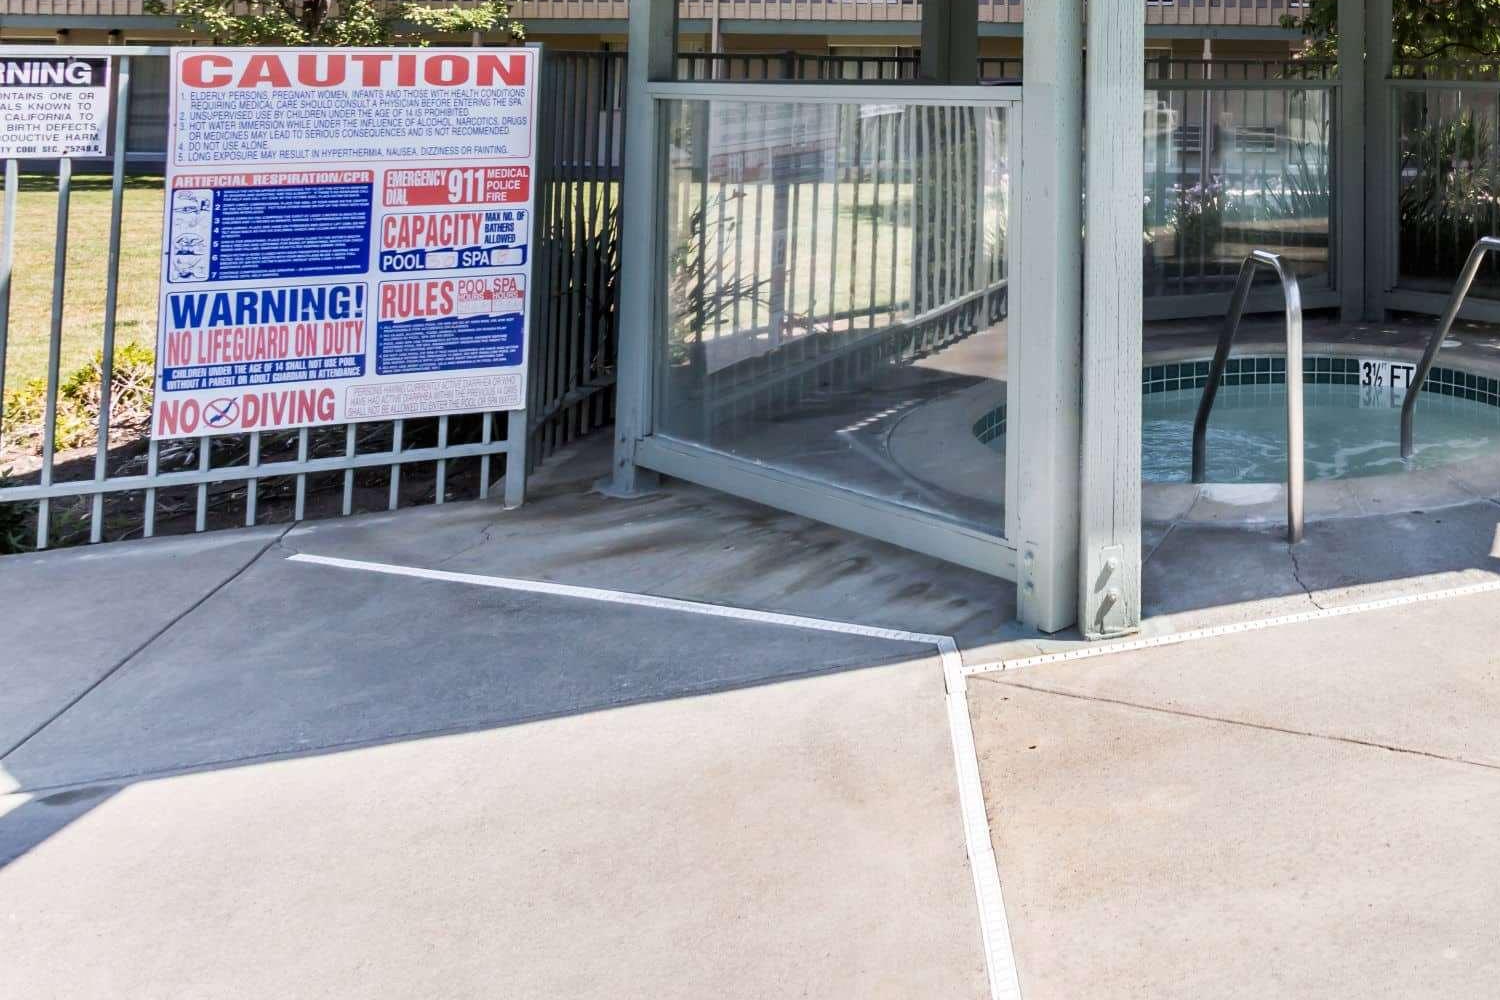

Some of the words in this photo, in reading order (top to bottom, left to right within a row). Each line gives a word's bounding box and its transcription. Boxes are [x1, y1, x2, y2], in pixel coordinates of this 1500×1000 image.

[0, 62, 92, 84] NING
[182, 54, 526, 89] CAUTION
[50, 92, 73, 100] ONE
[79, 92, 94, 100] OR
[190, 91, 225, 99] ELDERLY
[272, 90, 316, 99] PREGNANT
[351, 90, 384, 98] INFANTS
[385, 90, 401, 98] AND
[403, 89, 427, 97] THOSE
[430, 89, 448, 97] WITH
[450, 89, 478, 97] HEALTH
[480, 89, 525, 97] CONDITIONS
[28, 103, 71, 111] KNOWN
[191, 100, 236, 109] REQUIRING
[239, 100, 273, 109] MEDICAL
[276, 100, 298, 109] CARE
[300, 99, 332, 108] SHOULD
[334, 99, 370, 108] CONSULT
[372, 99, 377, 107] A
[379, 99, 419, 107] PHYSICIAN
[421, 98, 450, 107] BEFORE
[453, 98, 490, 107] ENTERING
[492, 98, 507, 106] THE
[5, 113, 72, 121] CALIFORNIA
[190, 110, 252, 120] UNSUPERVISED
[256, 110, 271, 119] USE
[273, 110, 284, 118] BY
[286, 110, 327, 118] CHILDREN
[328, 109, 355, 118] UNDER
[358, 109, 372, 117] THE
[374, 109, 389, 117] AGE
[392, 109, 403, 117] OF
[405, 109, 412, 117] 14
[7, 123, 41, 131] BIRTH
[189, 121, 207, 130] HOT
[209, 121, 235, 130] WATER
[238, 120, 284, 129] IMMERSION
[286, 120, 311, 128] WHILE
[313, 119, 341, 128] UNDER
[343, 119, 357, 128] THE
[360, 118, 403, 127] INFLUENCE
[405, 118, 414, 127] OF
[501, 117, 526, 125] DRUGS
[0, 134, 60, 142] ODUCTIVE
[189, 131, 200, 140] OR
[203, 130, 249, 140] MEDICINES
[251, 130, 267, 139] MAY
[269, 130, 290, 138] LEAD
[291, 130, 303, 138] TO
[304, 129, 340, 138] SERIOUS
[341, 128, 405, 137] CONSEQUENCES
[407, 128, 423, 136] AND
[425, 127, 432, 136] IS
[434, 127, 448, 136] NOT
[188, 141, 200, 151] DO
[202, 141, 220, 150] NOT
[222, 141, 239, 150] USE
[188, 151, 211, 161] LONG
[213, 150, 259, 160] EXPOSURE
[261, 150, 276, 159] MAY
[279, 149, 309, 159] RESULT
[311, 149, 319, 158] IN
[420, 146, 459, 156] DIZZINESS
[461, 146, 471, 155] OR
[175, 175, 248, 188] ARTIFICIAL
[253, 171, 369, 186] RESPIRATION/CPR
[387, 170, 448, 187] EMERGENCY
[487, 168, 528, 178] MEDICAL
[448, 168, 485, 203] 911
[486, 180, 521, 190] POLICE
[386, 188, 408, 205] DIAL
[486, 192, 507, 201] FIRE
[485, 212, 500, 222] MAX
[503, 212, 514, 221] NO.
[517, 211, 525, 220] OF
[383, 213, 482, 248] CAPACITY
[485, 222, 514, 233] BATHERS
[484, 233, 516, 244] ALLOWED
[383, 254, 424, 271] POOL
[462, 251, 490, 267] SPA
[458, 279, 488, 294] POOL
[494, 277, 517, 293] SPA
[382, 280, 454, 318] RULES
[171, 285, 364, 329] WARNING!
[168, 331, 192, 366] NO
[199, 325, 289, 364] LIFEGUARD
[295, 323, 317, 358] ON
[323, 320, 364, 356] DUTY
[172, 367, 207, 379] CHILDREN
[208, 365, 232, 377] UNDER
[235, 364, 247, 374] THE
[249, 363, 262, 373] AGE
[264, 362, 273, 372] OF
[275, 361, 283, 371] 14
[285, 360, 306, 371] SHALL
[308, 359, 322, 369] NOT
[324, 358, 336, 368] USE
[338, 357, 356, 367] POOL
[167, 378, 200, 390] WITHOUT
[201, 378, 207, 388] A
[209, 376, 235, 388] PARENT
[237, 375, 247, 385] OR
[250, 373, 270, 384] ADULT
[272, 371, 307, 382] GUARDIAN
[309, 370, 317, 379] IN
[318, 367, 360, 379] ATTENDANCE
[1391, 365, 1414, 387] FT
[158, 398, 200, 436] NO
[241, 388, 335, 428] DIVING
